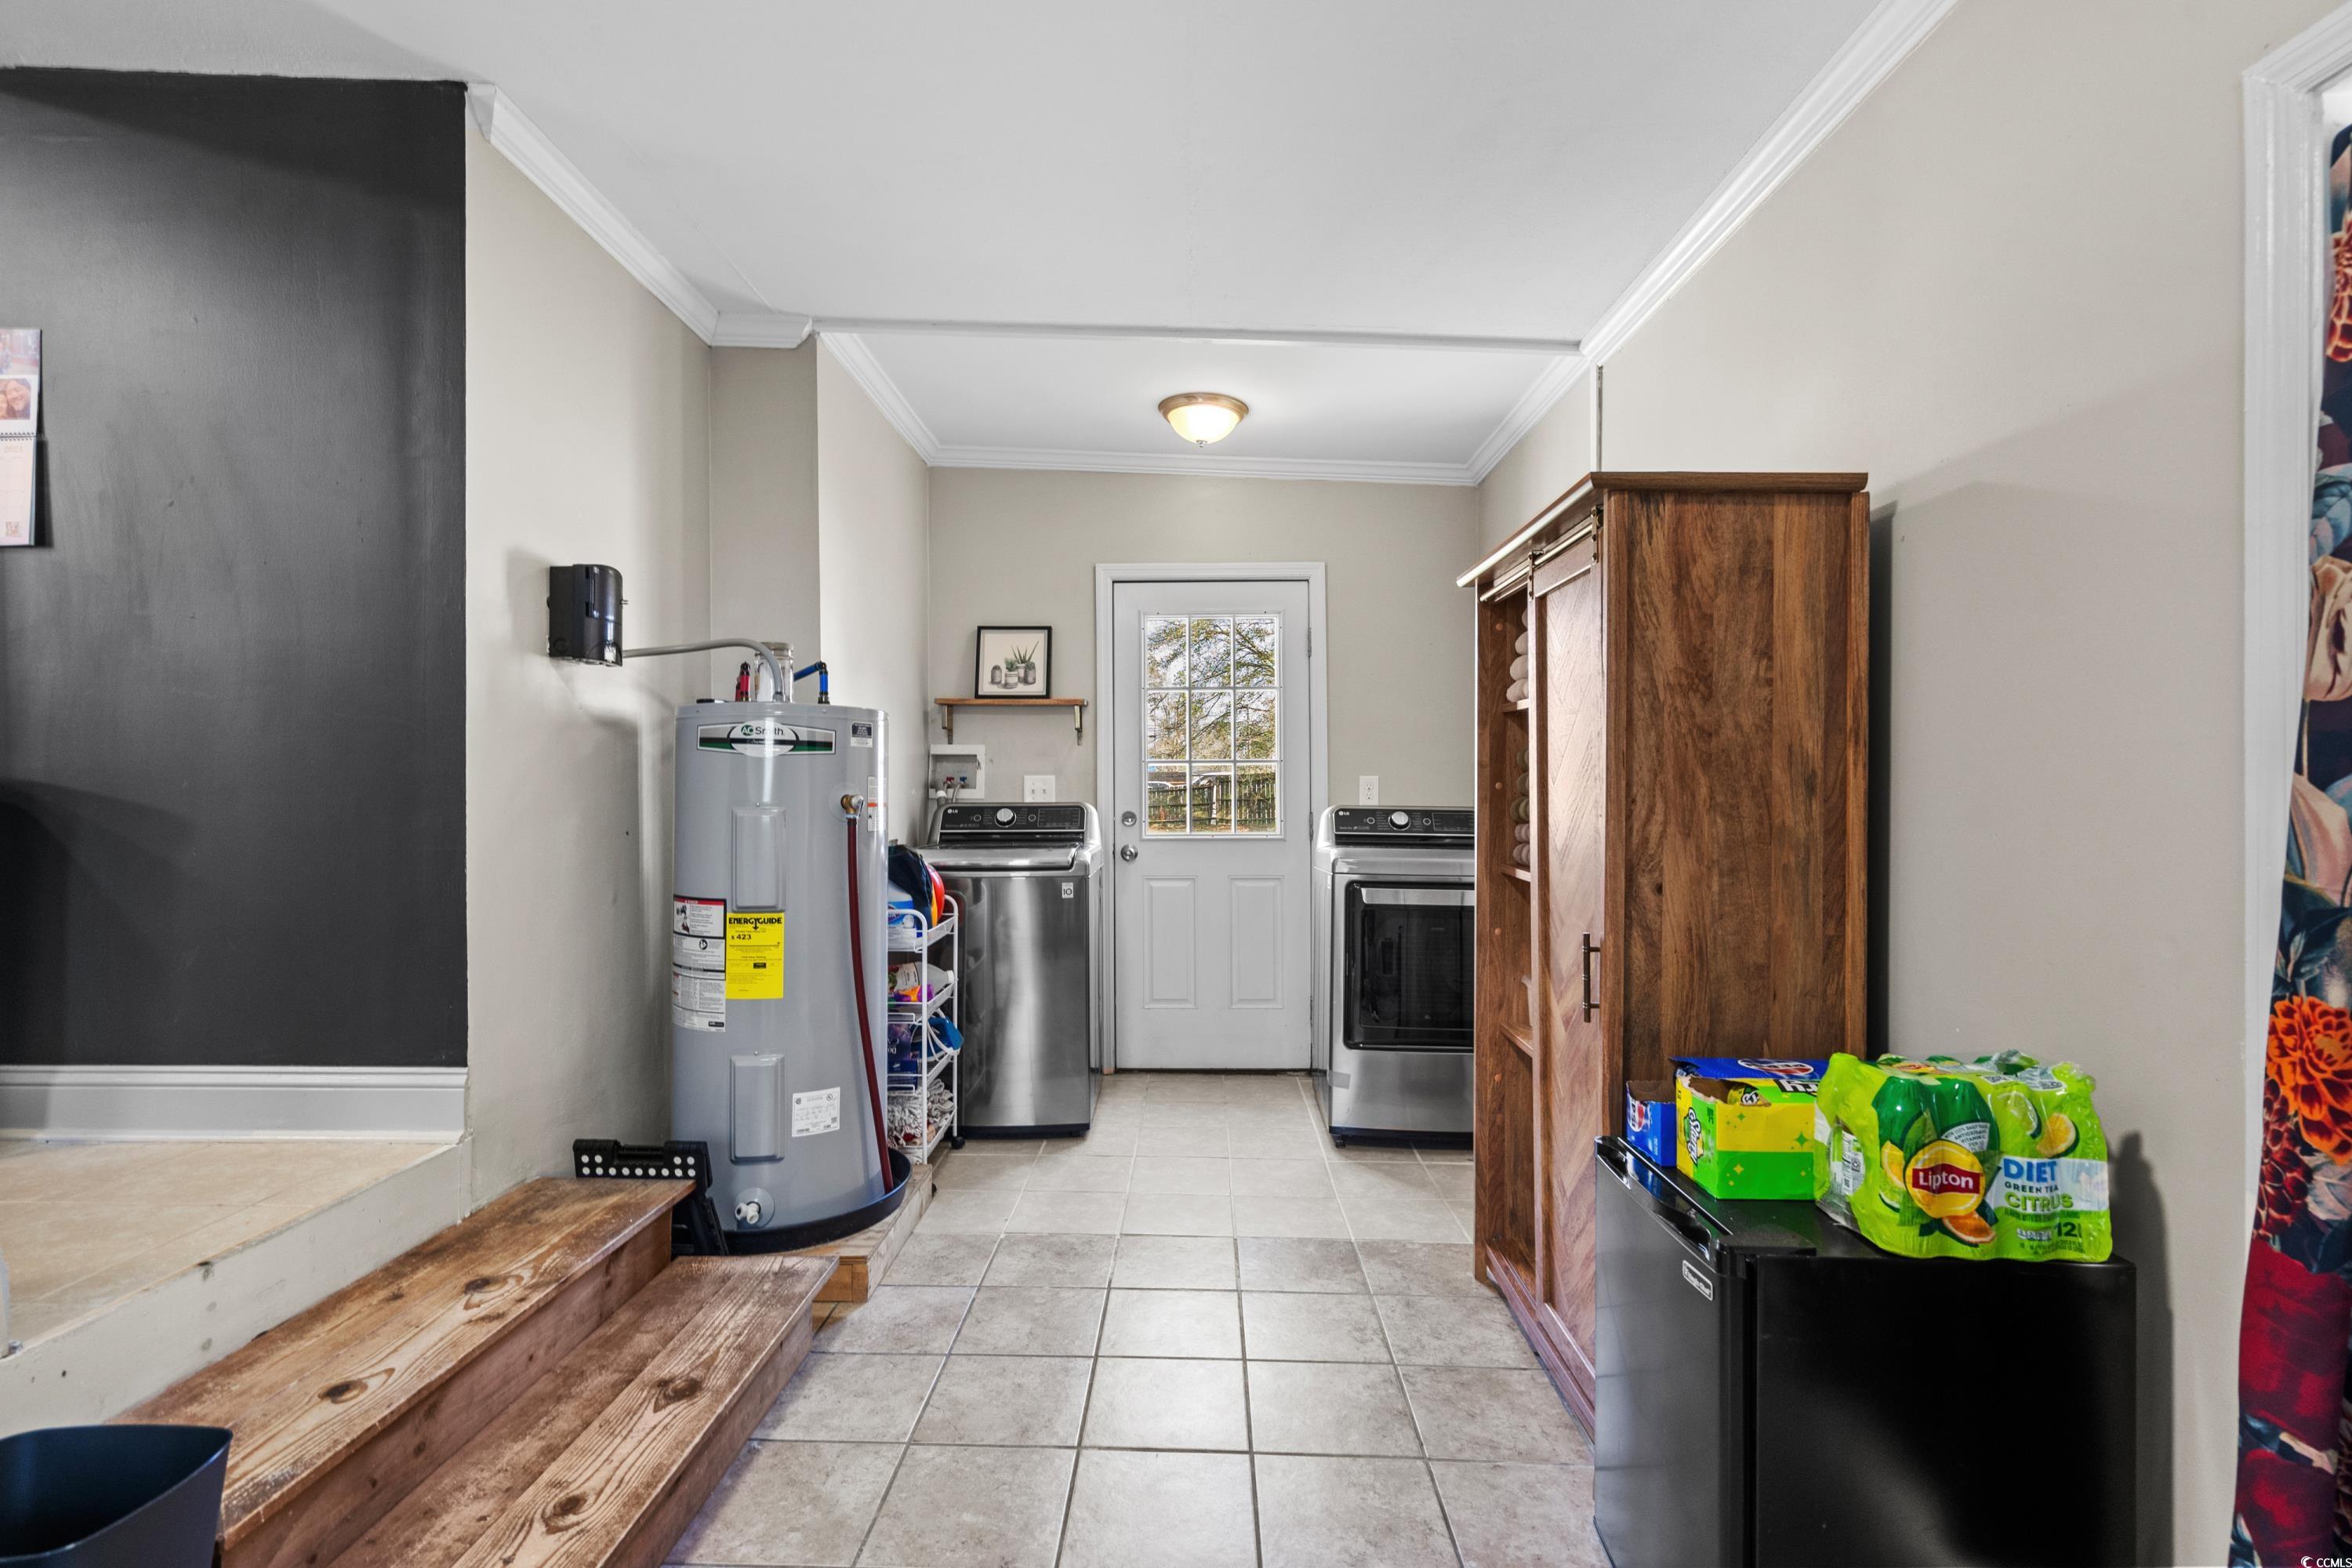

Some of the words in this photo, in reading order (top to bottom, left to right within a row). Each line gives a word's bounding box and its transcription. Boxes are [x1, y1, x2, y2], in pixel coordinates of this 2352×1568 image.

[755, 726, 785, 735] Sth
[2003, 1158, 2057, 1183] DIET
[1918, 1171, 1974, 1190] Lipton
[2005, 1181, 2042, 1193] GREEN
[2045, 1184, 2060, 1193] TEA
[2004, 1192, 2074, 1212] CITRUS
[2055, 1221, 2078, 1237] 12
